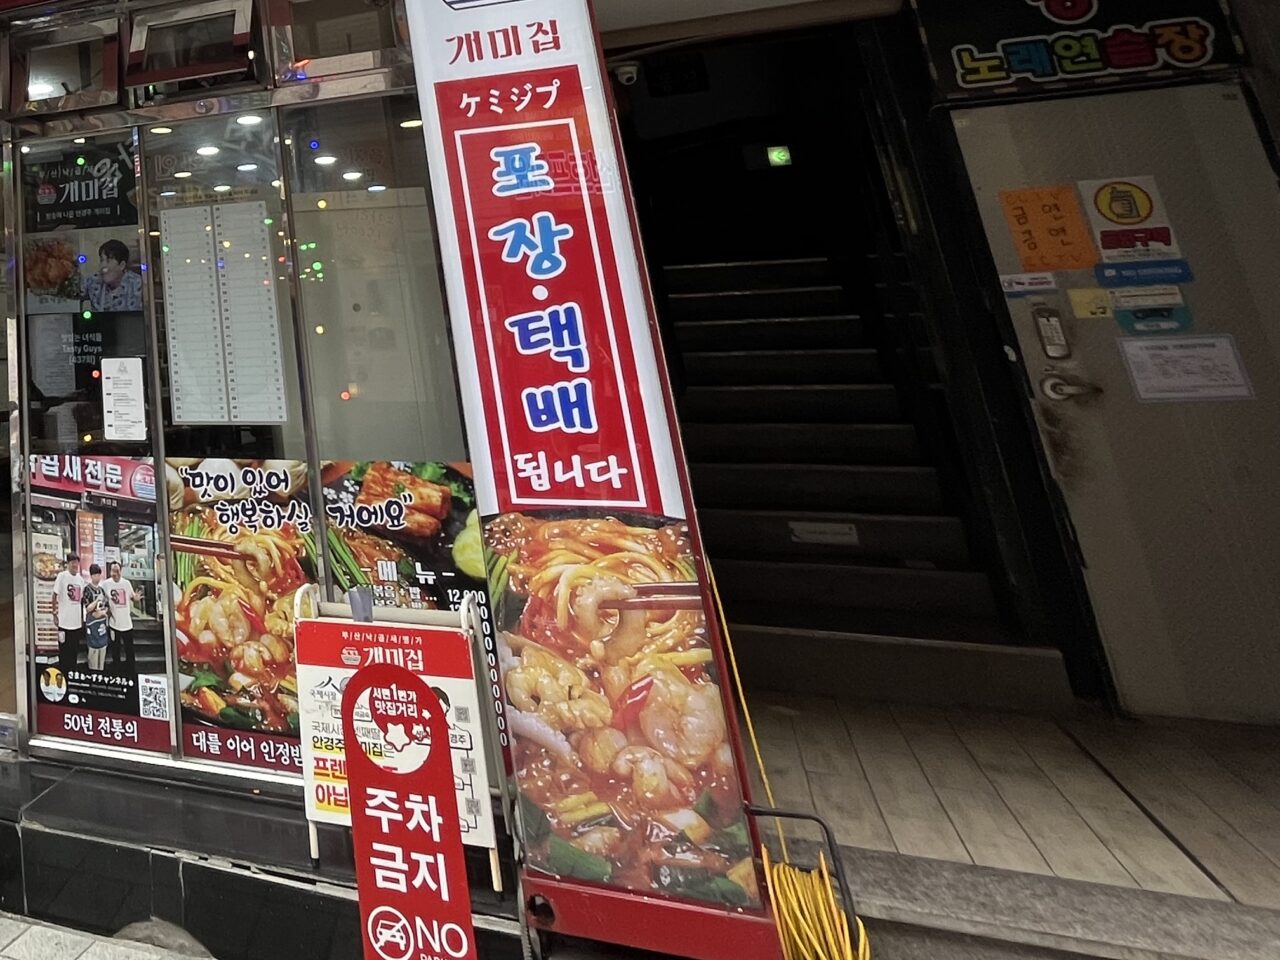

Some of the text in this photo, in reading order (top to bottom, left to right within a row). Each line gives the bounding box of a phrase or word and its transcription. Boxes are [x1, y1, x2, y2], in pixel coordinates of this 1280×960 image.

[445, 19, 562, 65] 개미집
[459, 79, 561, 118] ケミジプ
[59, 178, 119, 204] 개미집
[241, 468, 290, 498] 있어
[513, 450, 629, 492] 됩니다
[215, 500, 313, 534] 행복하실
[362, 646, 425, 672] 개미집
[372, 683, 417, 704] 서면1번가
[374, 701, 418, 719] 맛집거리
[64, 713, 139, 743] 50년 전통의
[191, 732, 256, 756] 대를 이어
[364, 787, 444, 843] 주차
[370, 842, 450, 902] 금지
[414, 916, 469, 959] NO
